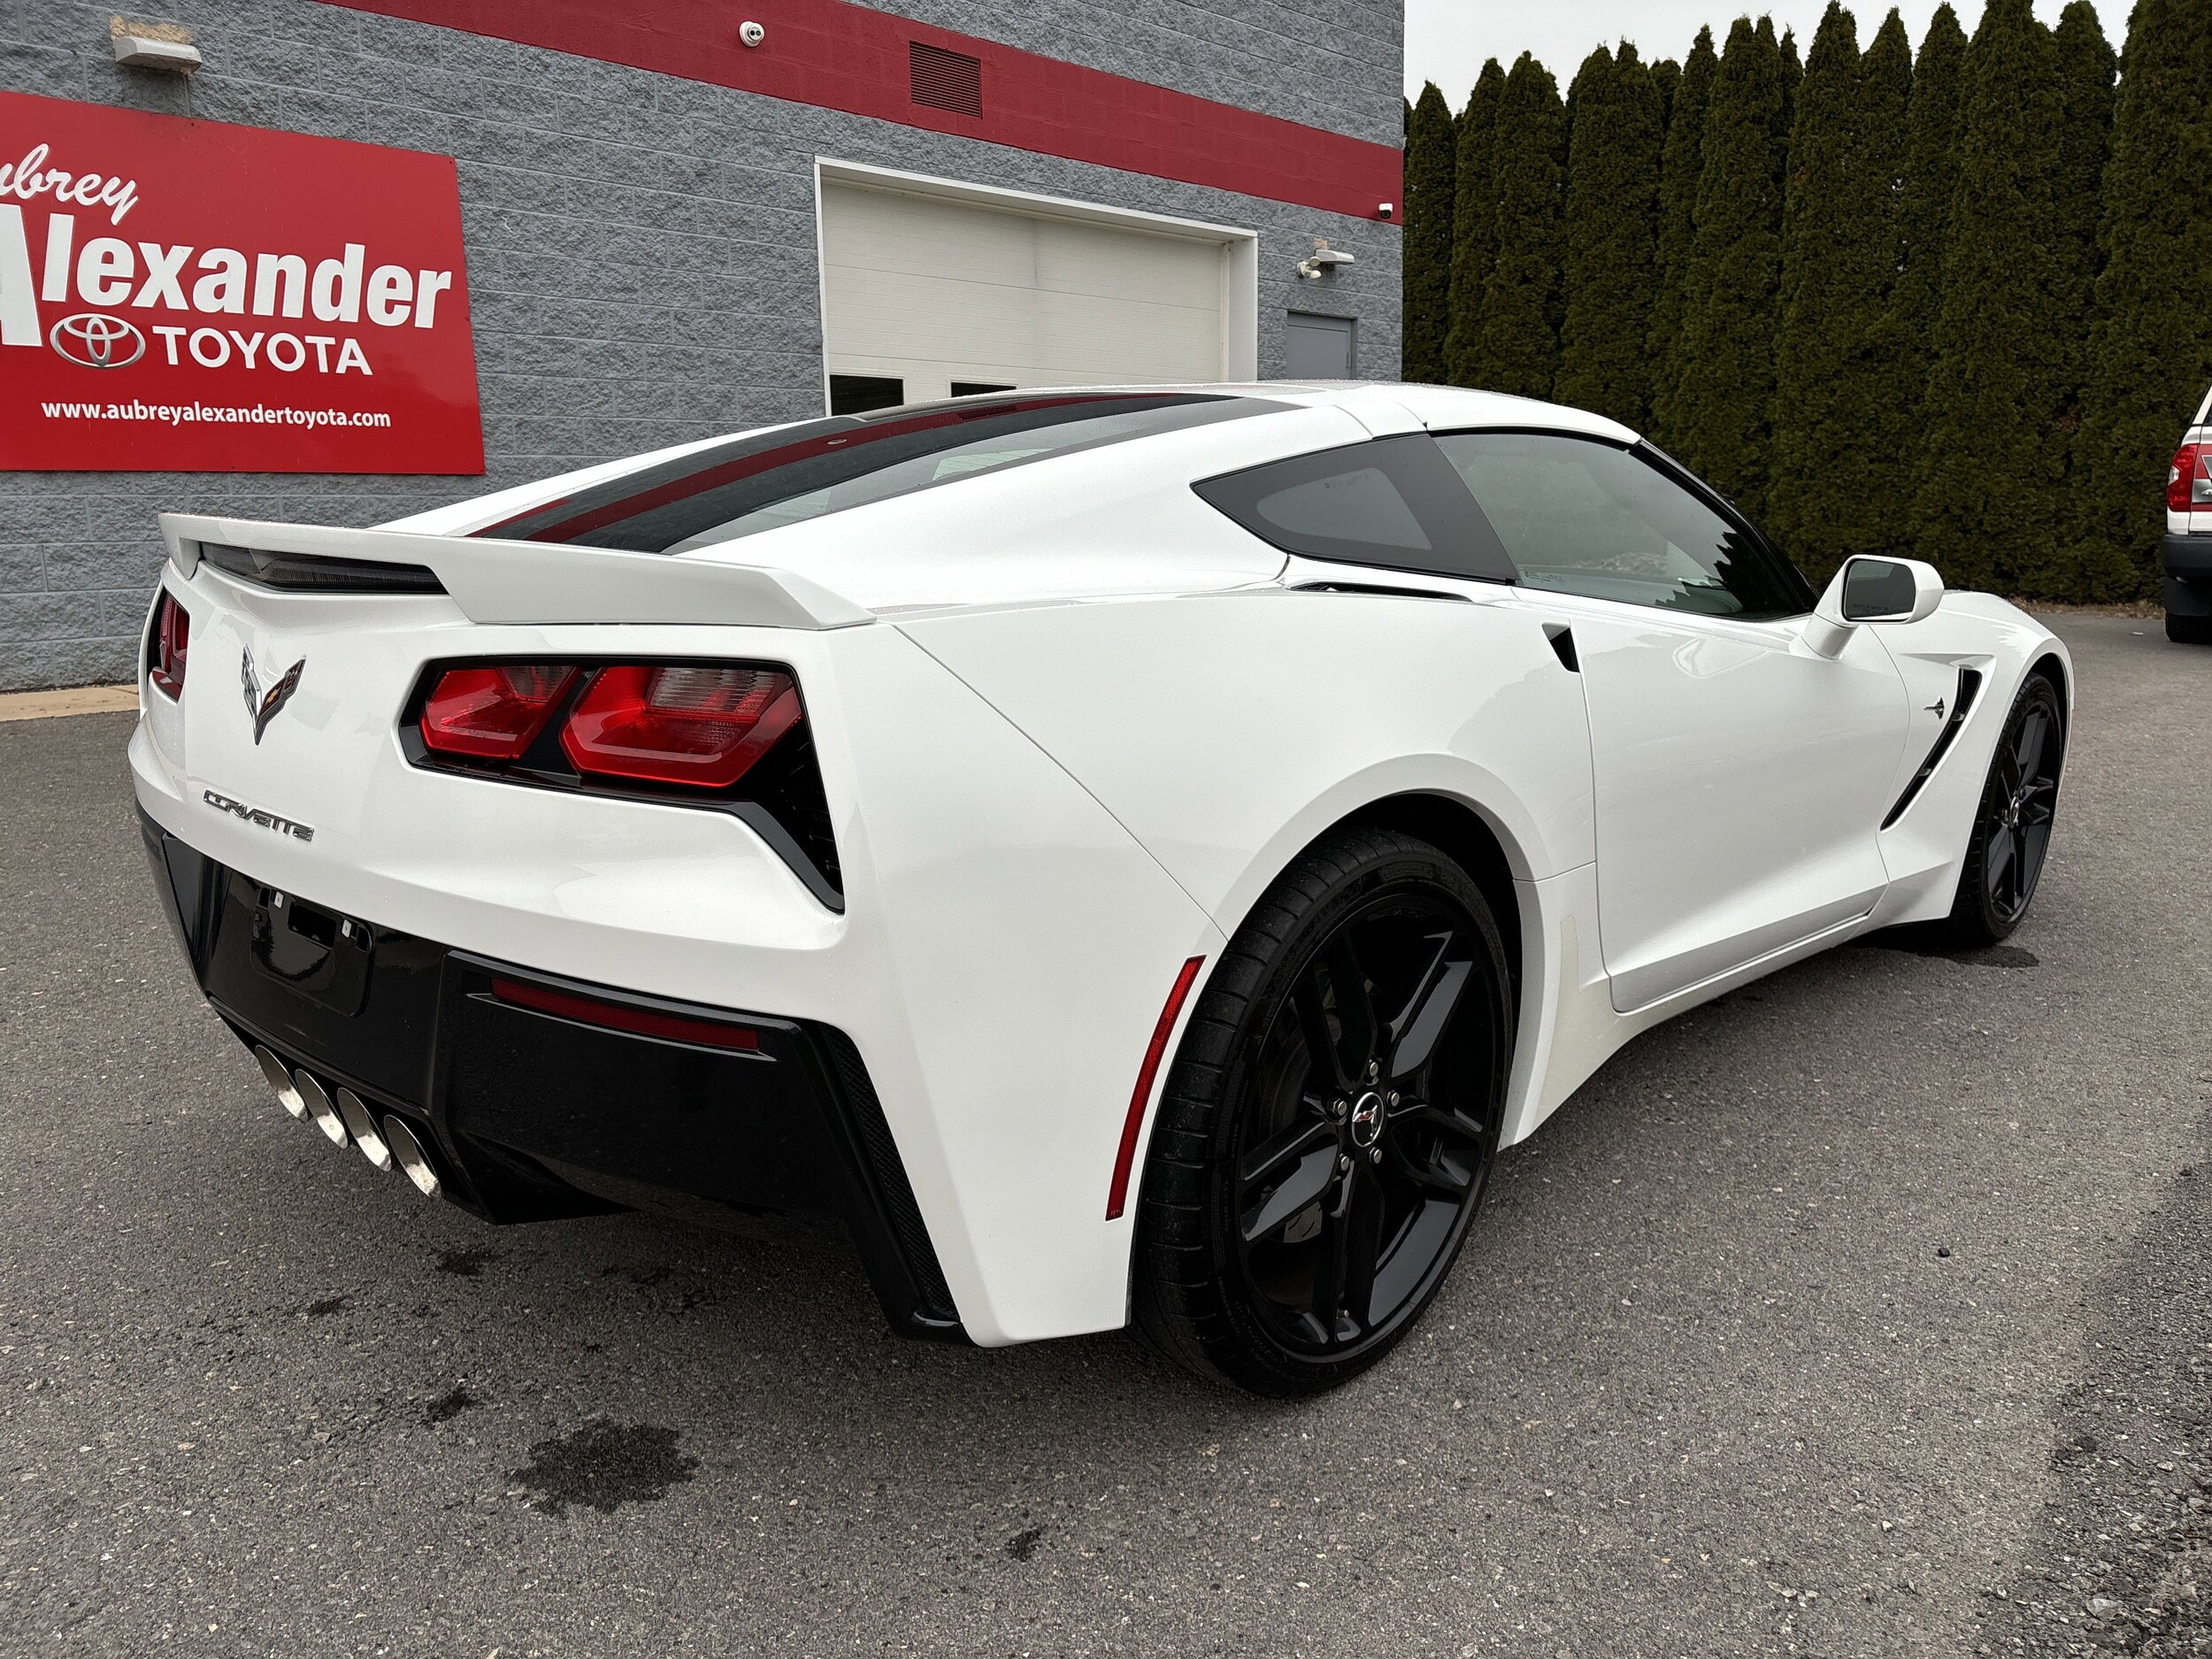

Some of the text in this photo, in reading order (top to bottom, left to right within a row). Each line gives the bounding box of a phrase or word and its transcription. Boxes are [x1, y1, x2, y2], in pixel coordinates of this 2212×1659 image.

[152, 325, 373, 376] TOYOTA
[41, 399, 392, 430] www.aubreyalexandertoyota.com
[203, 789, 315, 842] CORVETTE
